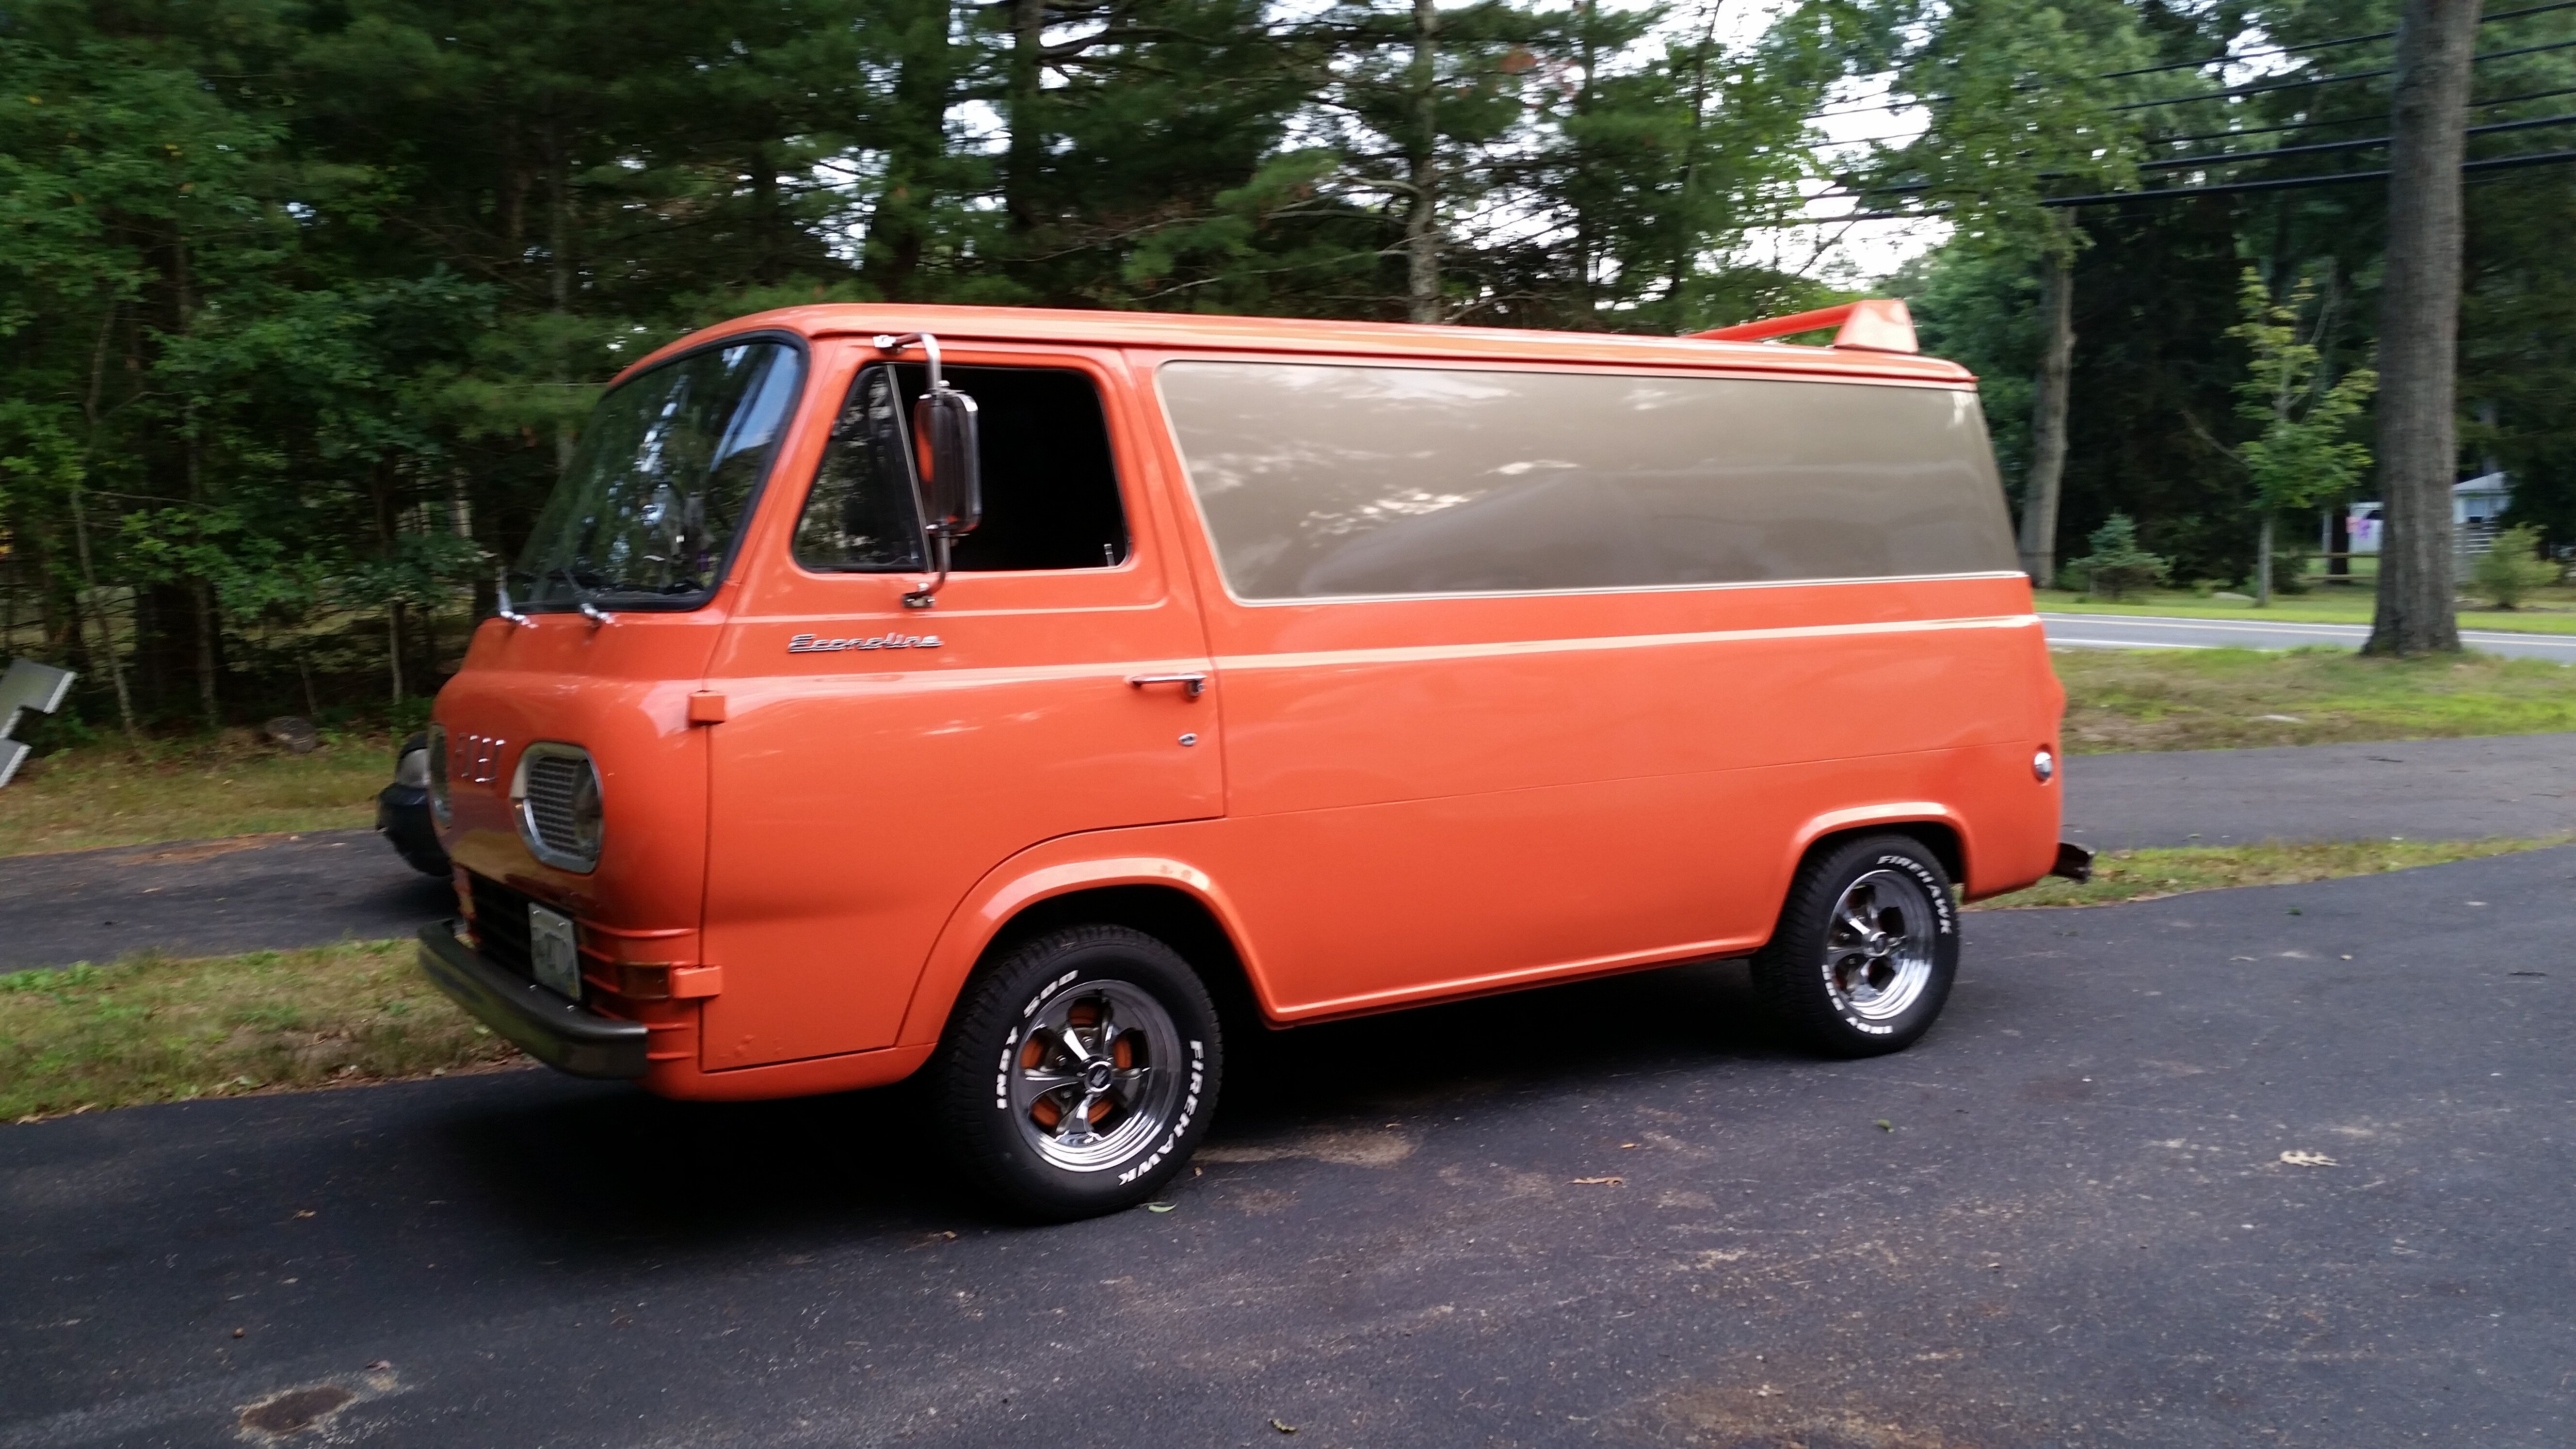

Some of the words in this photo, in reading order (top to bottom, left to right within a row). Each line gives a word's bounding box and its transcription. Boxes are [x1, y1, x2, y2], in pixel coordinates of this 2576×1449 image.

[788, 632, 944, 653] Econoline
[1876, 855, 1952, 935] FIREHAWK
[1023, 969, 1079, 1018] 500
[1118, 1040, 1204, 1186] FIREHAWK
